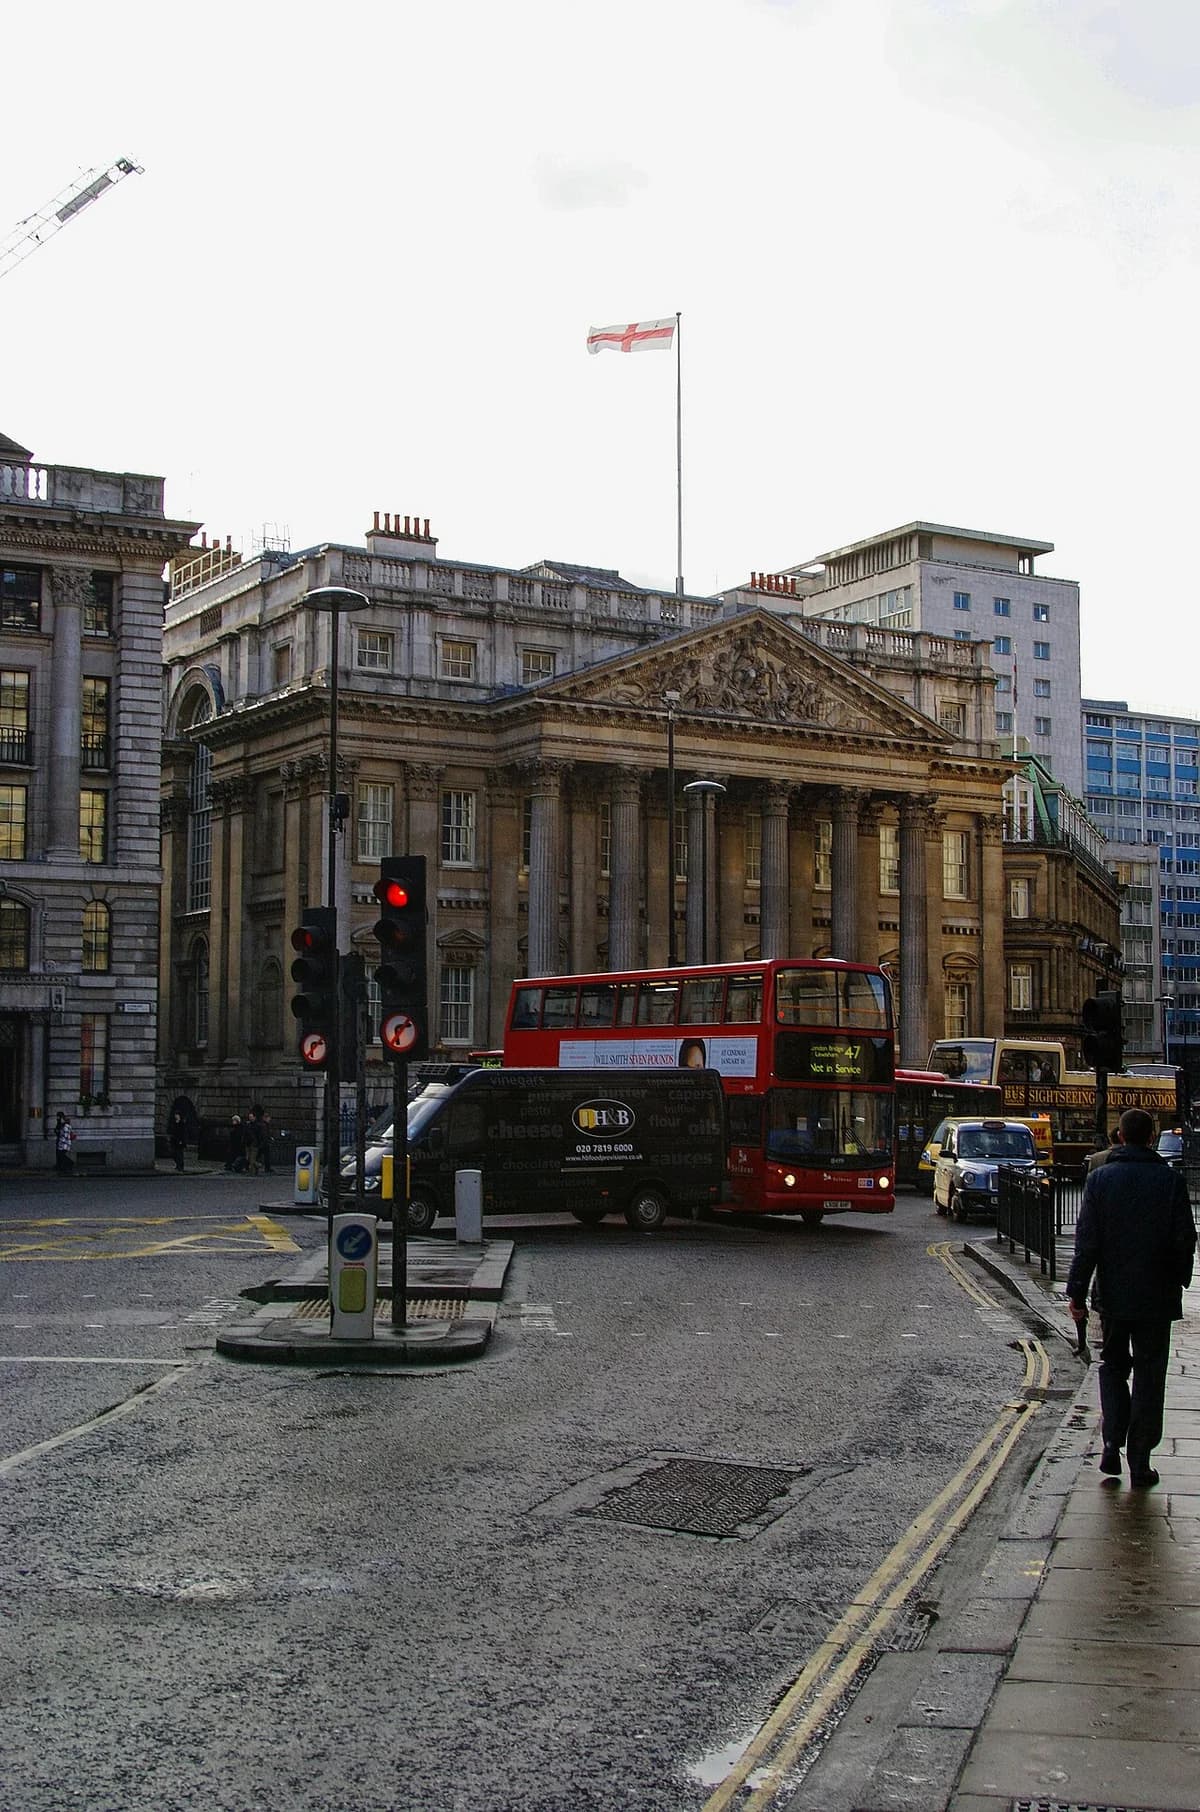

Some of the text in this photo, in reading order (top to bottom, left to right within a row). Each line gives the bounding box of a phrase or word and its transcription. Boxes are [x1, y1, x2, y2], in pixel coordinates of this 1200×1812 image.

[844, 1045, 862, 1059] 47
[593, 1055, 609, 1065] WILL
[609, 1055, 628, 1065] SMITH
[628, 1054, 647, 1065] SEVEN
[647, 1054, 674, 1065] POUNDS
[826, 1063, 834, 1073] in
[835, 1063, 862, 1074] Service
[490, 1074, 546, 1088] vinegars
[669, 1089, 714, 1103] capers
[1005, 1089, 1025, 1099] BUS
[1028, 1089, 1096, 1105] SIGHTSEEING
[1125, 1092, 1138, 1106] OF
[1140, 1093, 1177, 1107] LONDON
[648, 1114, 681, 1127] flour
[688, 1118, 721, 1135] oils
[488, 1119, 564, 1139] cheese
[576, 1143, 633, 1153] 020 7819 6000
[503, 1158, 561, 1170] chocolate
[650, 1153, 713, 1165] sauces
